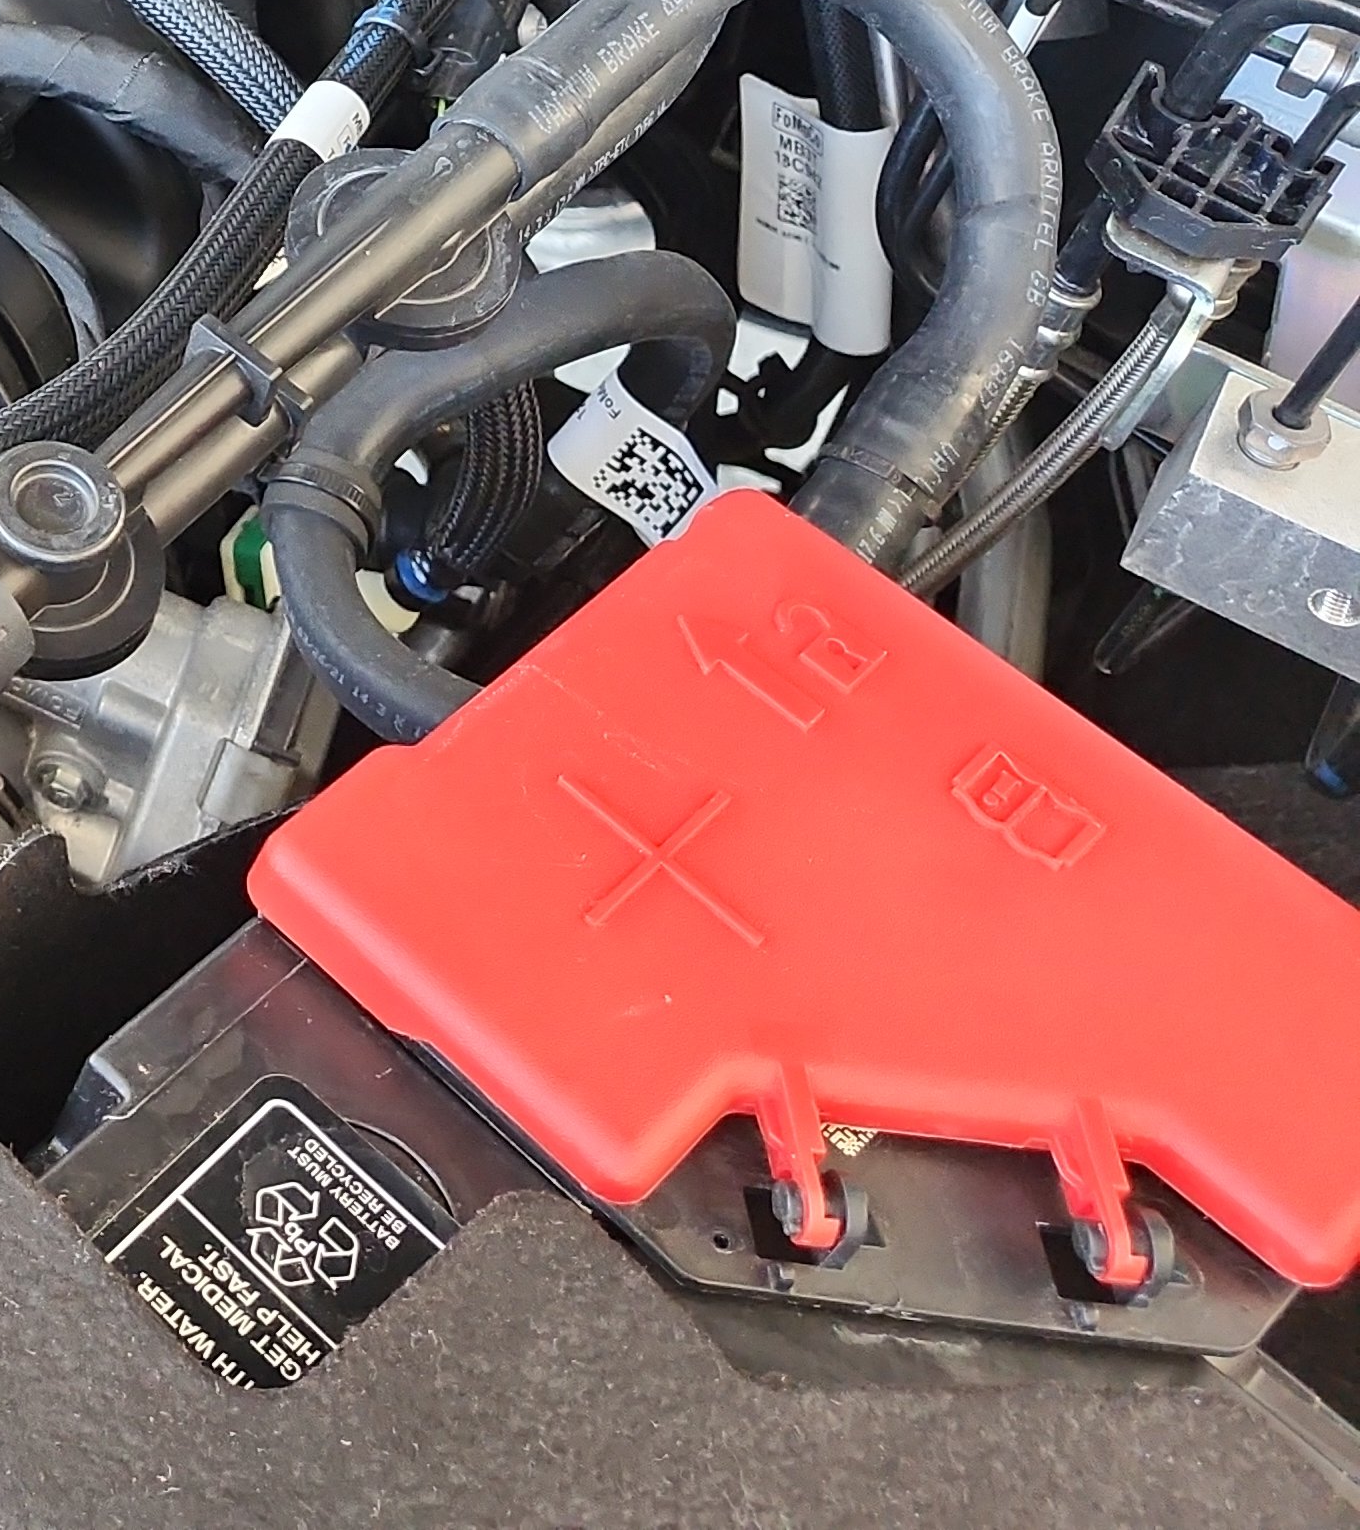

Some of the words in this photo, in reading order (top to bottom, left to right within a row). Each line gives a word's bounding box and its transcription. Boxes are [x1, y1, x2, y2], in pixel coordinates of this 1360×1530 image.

[596, 13, 661, 73] BRAKE
[1000, 44, 1053, 123] BRAKE
[286, 1145, 333, 1189] MUST
[304, 1138, 380, 1213] RECYCLED
[283, 1221, 319, 1257] Pb
[328, 1188, 401, 1252] BATTERY
[379, 1210, 408, 1236] BE
[159, 1235, 258, 1337] MEDICAL
[198, 1243, 261, 1307] FAST.
[136, 1271, 217, 1361] WATER.
[256, 1307, 321, 1365] HELP
[249, 1335, 302, 1382] GET
